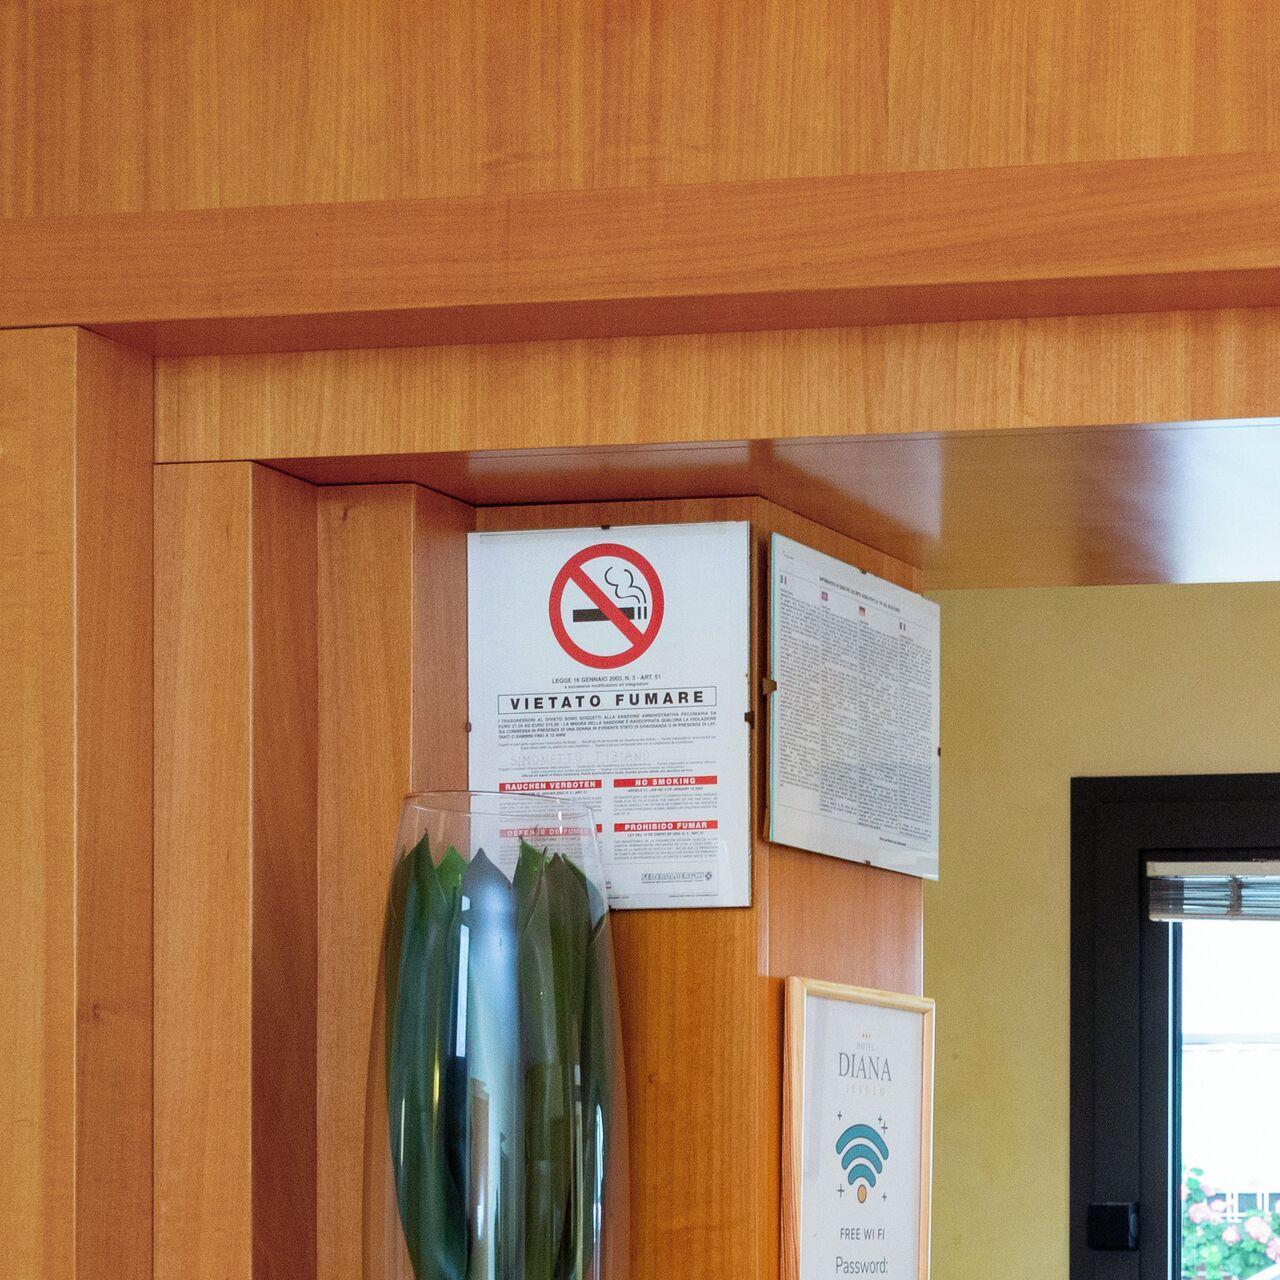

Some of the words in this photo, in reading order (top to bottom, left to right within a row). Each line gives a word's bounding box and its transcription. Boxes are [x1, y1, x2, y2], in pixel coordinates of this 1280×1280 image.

[510, 695, 601, 710] VIETATO
[615, 691, 703, 706] FUMARE
[505, 782, 546, 791] RAUCHEN
[549, 780, 596, 789] VERBOTEN
[652, 777, 696, 785] SMOKING
[624, 822, 673, 831] PROHIBIDO
[676, 821, 708, 830] FUMAR
[838, 1051, 892, 1081] DIANA
[840, 1228, 861, 1240] FREE
[863, 1228, 875, 1240] WI
[877, 1228, 885, 1240] FI
[835, 1255, 889, 1274] Password:
